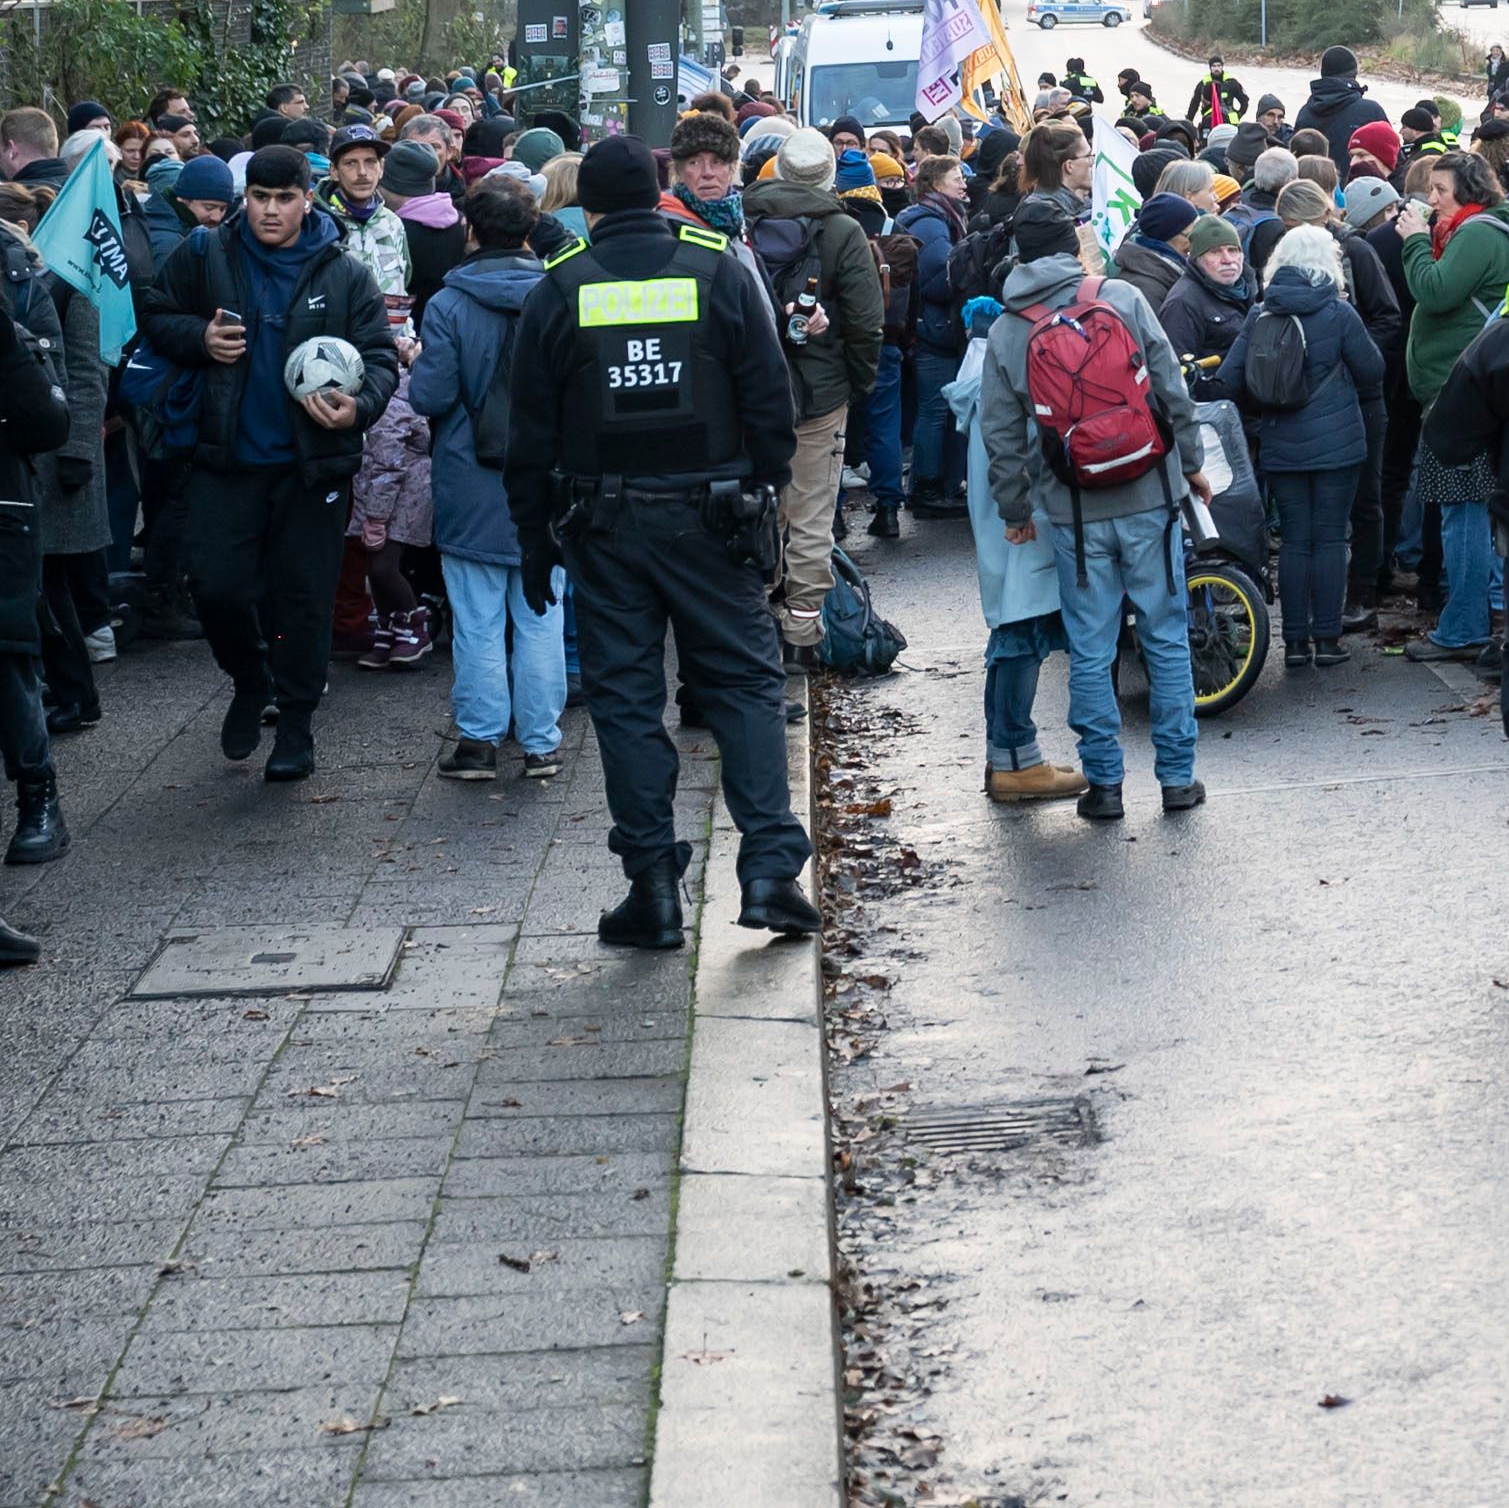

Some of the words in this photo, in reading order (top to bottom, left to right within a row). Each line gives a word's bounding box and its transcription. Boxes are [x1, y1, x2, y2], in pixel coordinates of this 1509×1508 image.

[582, 281, 693, 322] POLIZEI
[627, 338, 661, 362] BE
[608, 361, 682, 388] 35317
